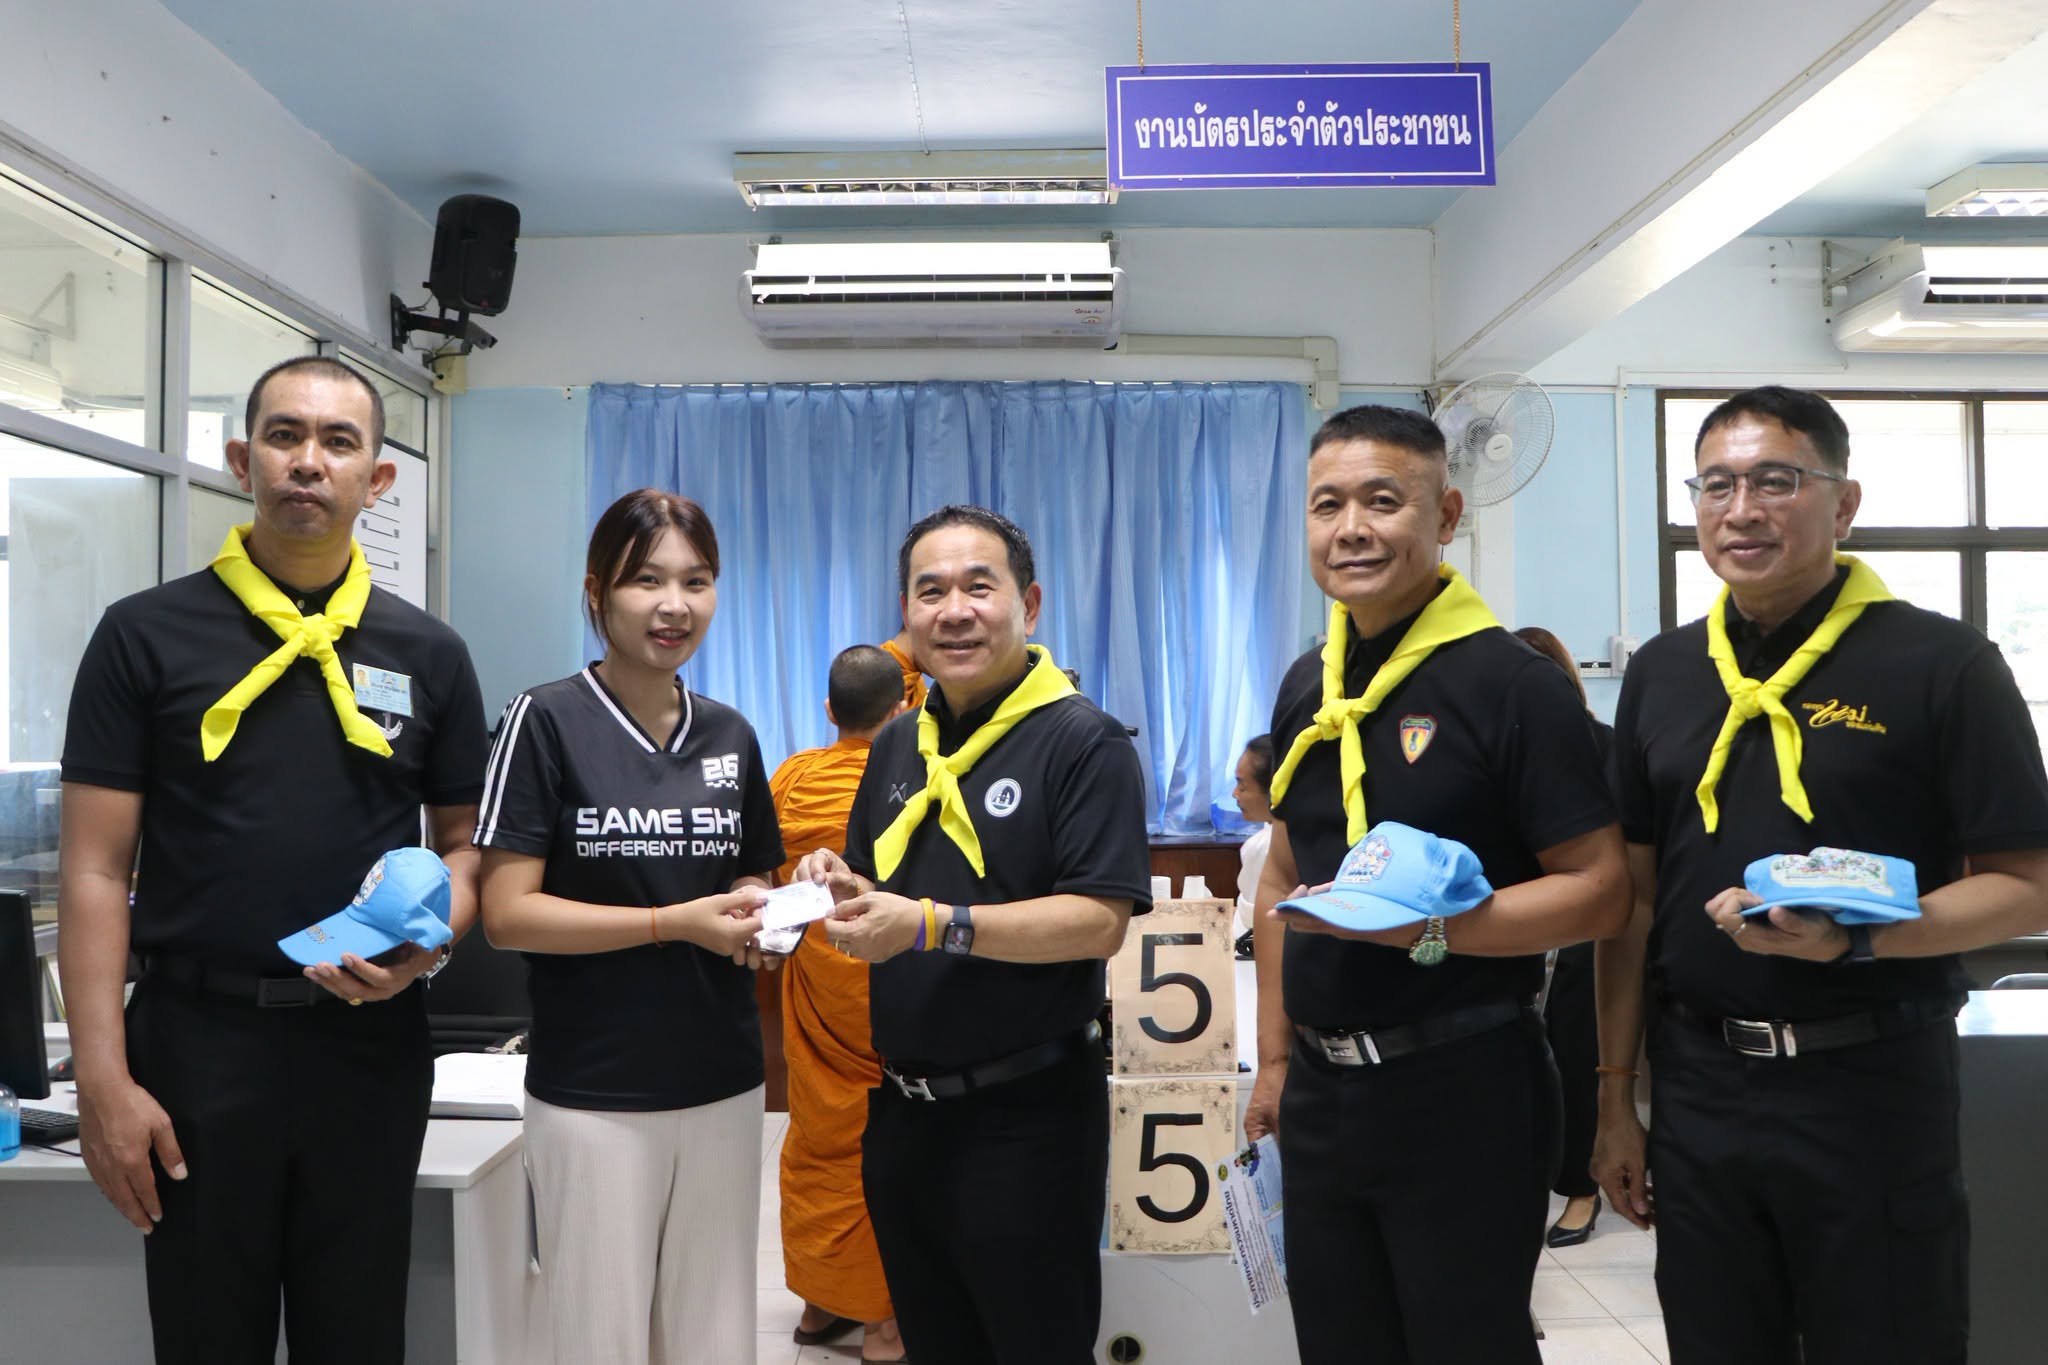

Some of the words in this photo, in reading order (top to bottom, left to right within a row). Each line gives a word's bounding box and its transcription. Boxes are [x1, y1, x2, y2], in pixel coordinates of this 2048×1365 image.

[1134, 100, 1472, 149] งานบัตรประจำตัวประชาชน
[701, 753, 739, 781] 26
[575, 806, 684, 835] SAME
[575, 840, 688, 857] DIFFERENT
[1138, 933, 1212, 1043] 5
[1136, 1113, 1210, 1223] 5
